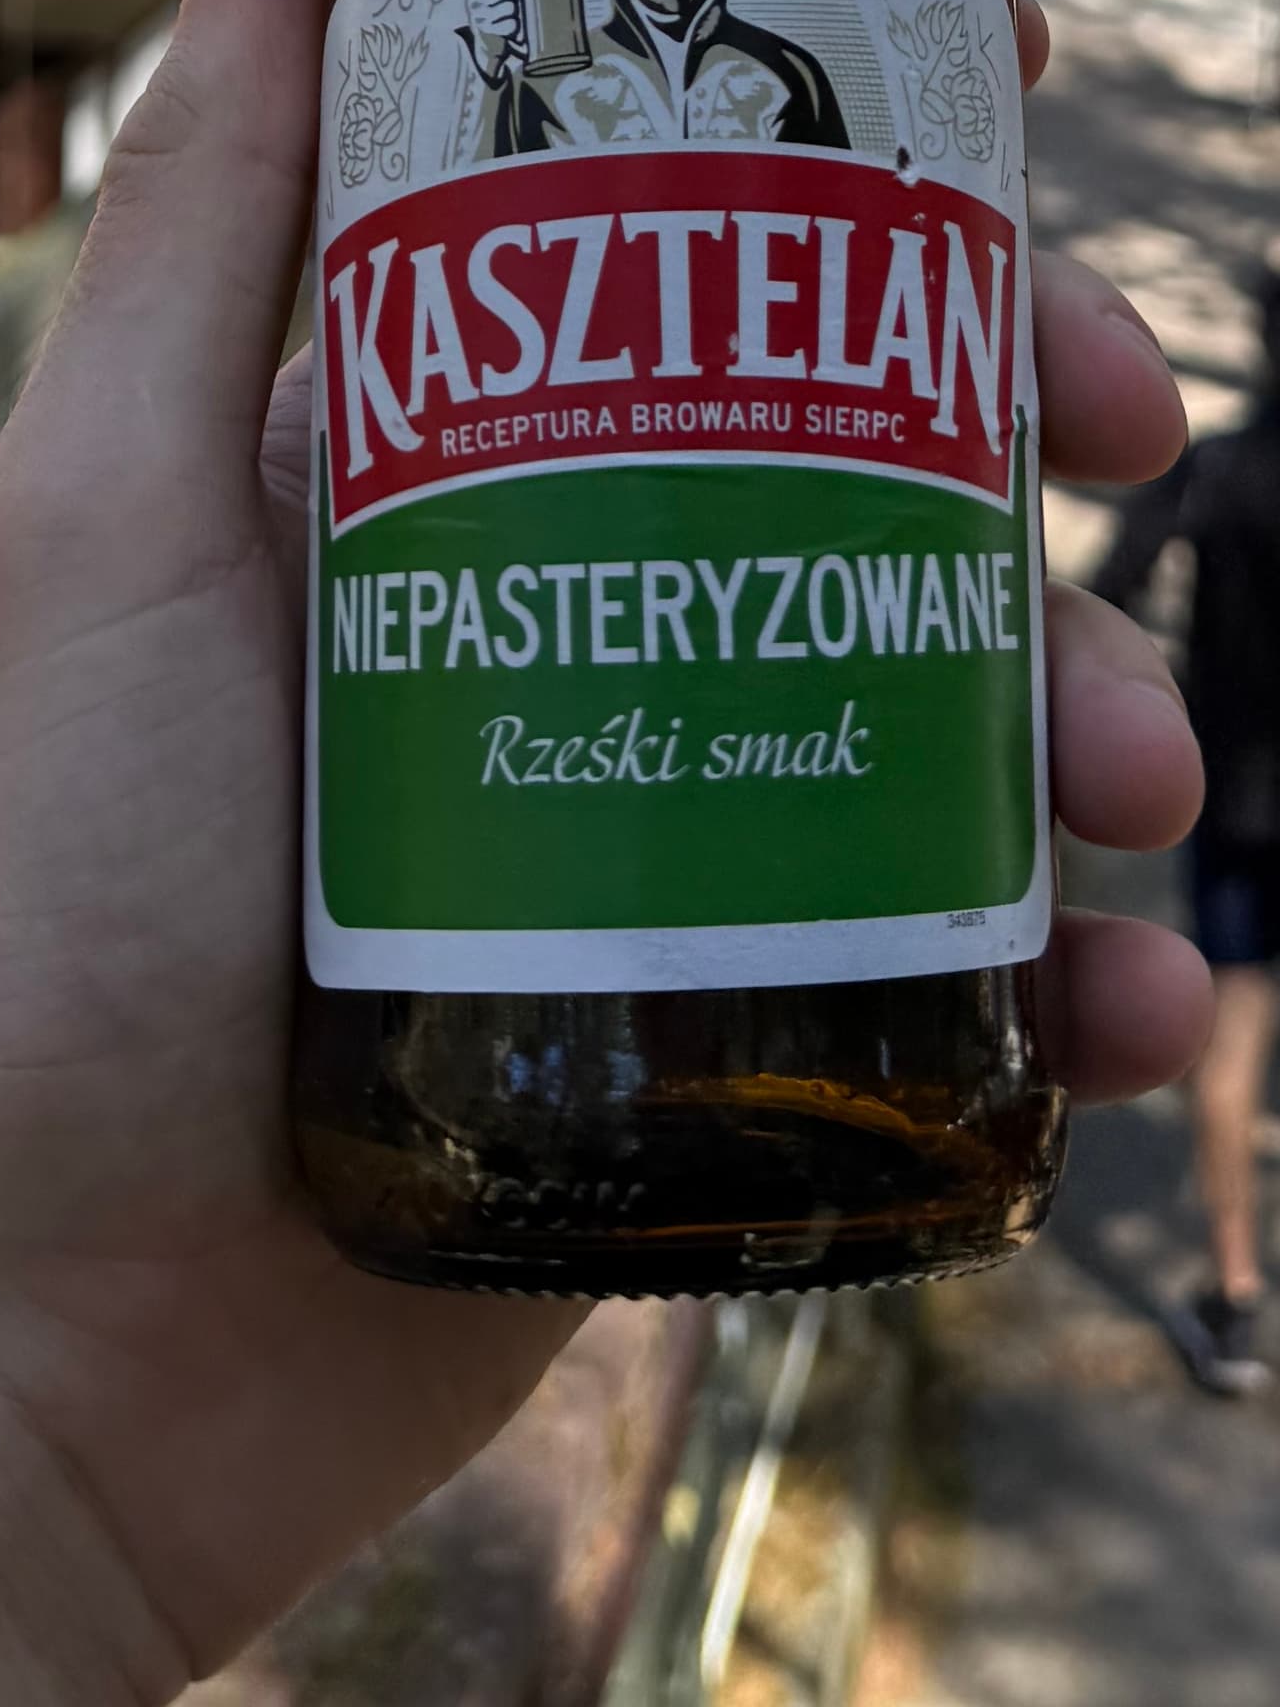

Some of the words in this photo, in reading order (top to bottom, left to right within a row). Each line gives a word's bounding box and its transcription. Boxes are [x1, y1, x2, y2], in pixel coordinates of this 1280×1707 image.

[329, 209, 1009, 481] KASZTELAN
[441, 406, 618, 458] RECEPTURA
[631, 401, 792, 433] BROWARU
[805, 403, 907, 443] SIERPC
[333, 552, 1019, 674] NIEPASTERYZOWANE
[480, 706, 690, 786] Rześki
[701, 700, 874, 779] smak
